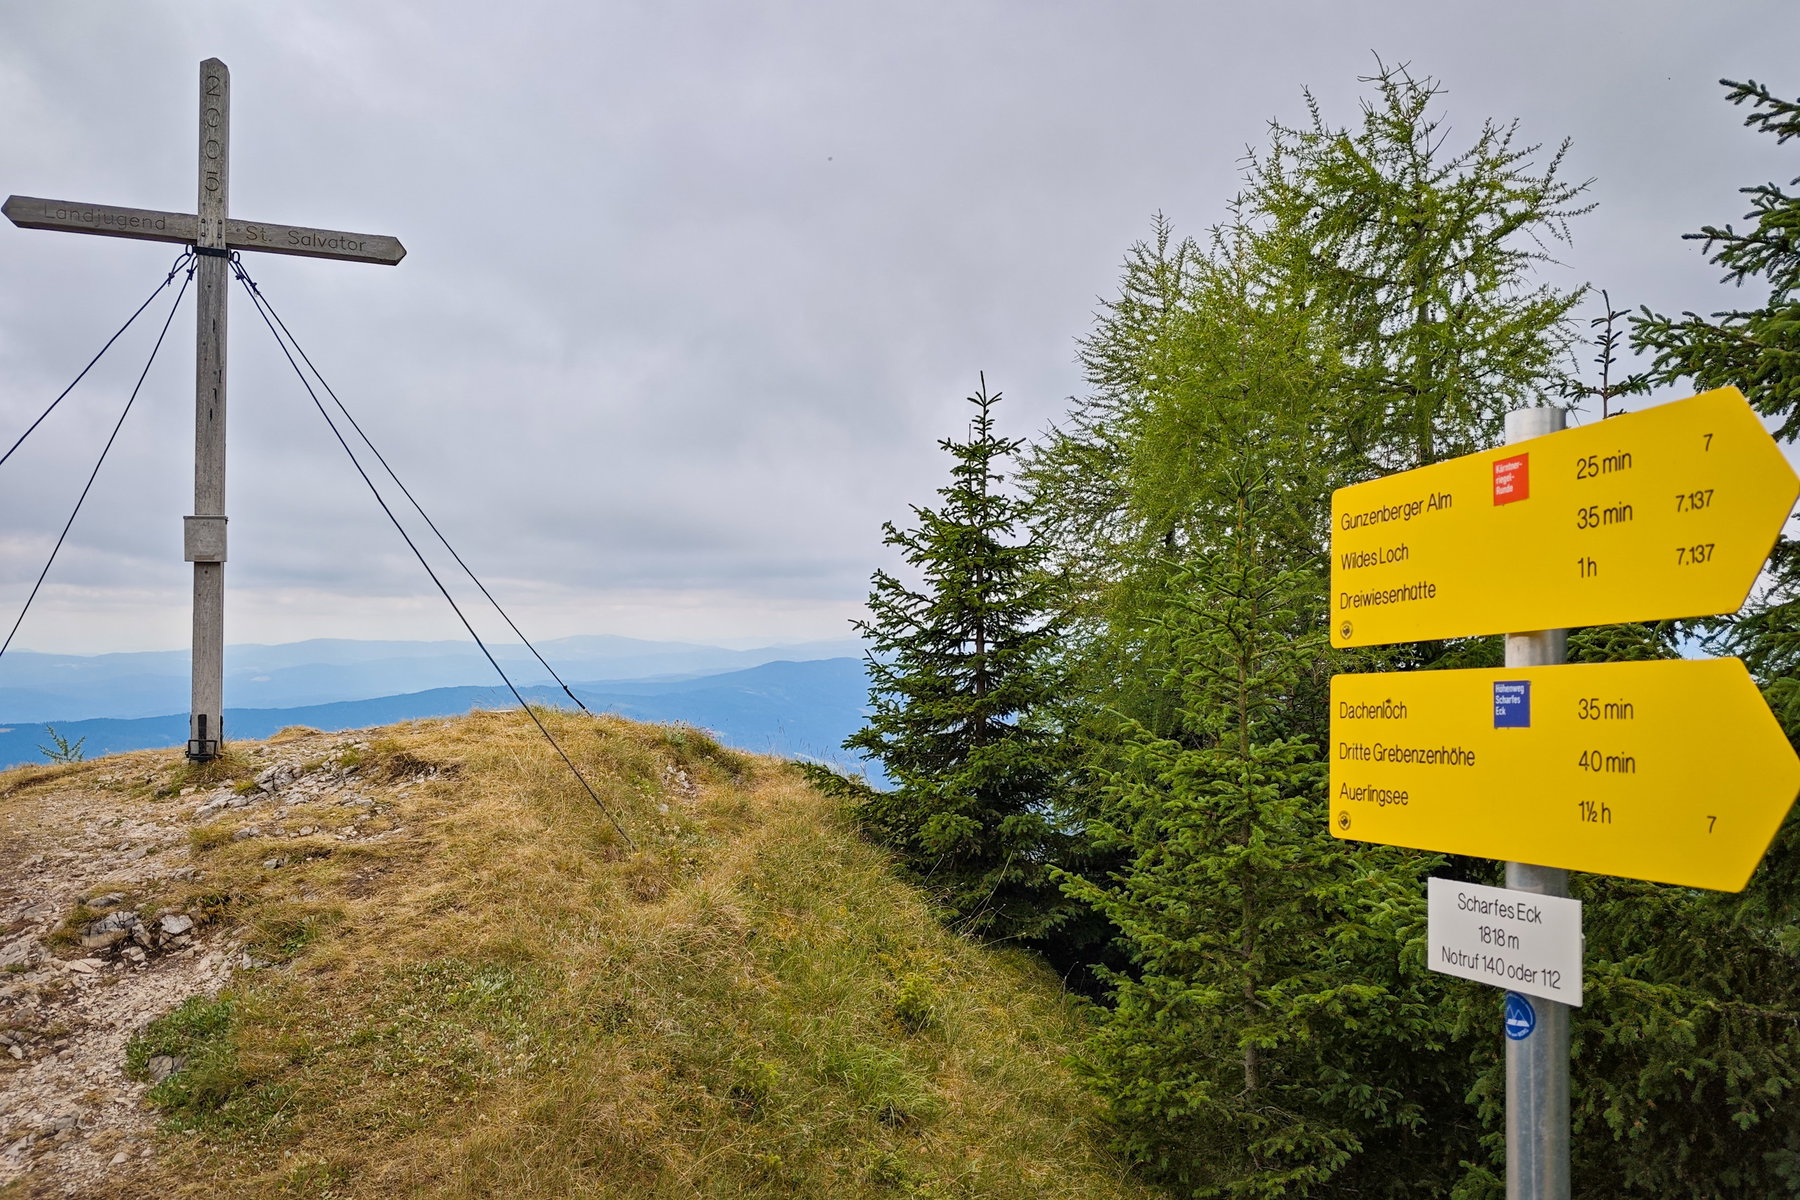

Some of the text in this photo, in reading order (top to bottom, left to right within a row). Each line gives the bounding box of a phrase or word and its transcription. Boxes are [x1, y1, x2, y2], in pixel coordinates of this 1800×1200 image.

[205, 75, 221, 192] 2005
[44, 203, 367, 252] Landjugend St. Salvator
[1703, 433, 1713, 451] 7
[1577, 450, 1632, 480] 25 min
[1341, 492, 1452, 531] Gunzenberger Alm
[1577, 501, 1633, 529] 35 min
[1341, 543, 1409, 570] Wildes Loch
[1495, 706, 1506, 716] Eck
[1578, 698, 1634, 720] 35 min
[1340, 742, 1475, 766] Dritte Grebenzenhöhe
[1579, 750, 1635, 774] 40 min
[1340, 782, 1408, 807] Auerlingsee
[1706, 815, 1717, 834] 7
[1458, 892, 1542, 924] Scharfes Eck
[1478, 925, 1520, 950] 1818 m
[1441, 946, 1561, 990] Notruf 140 oder 112
